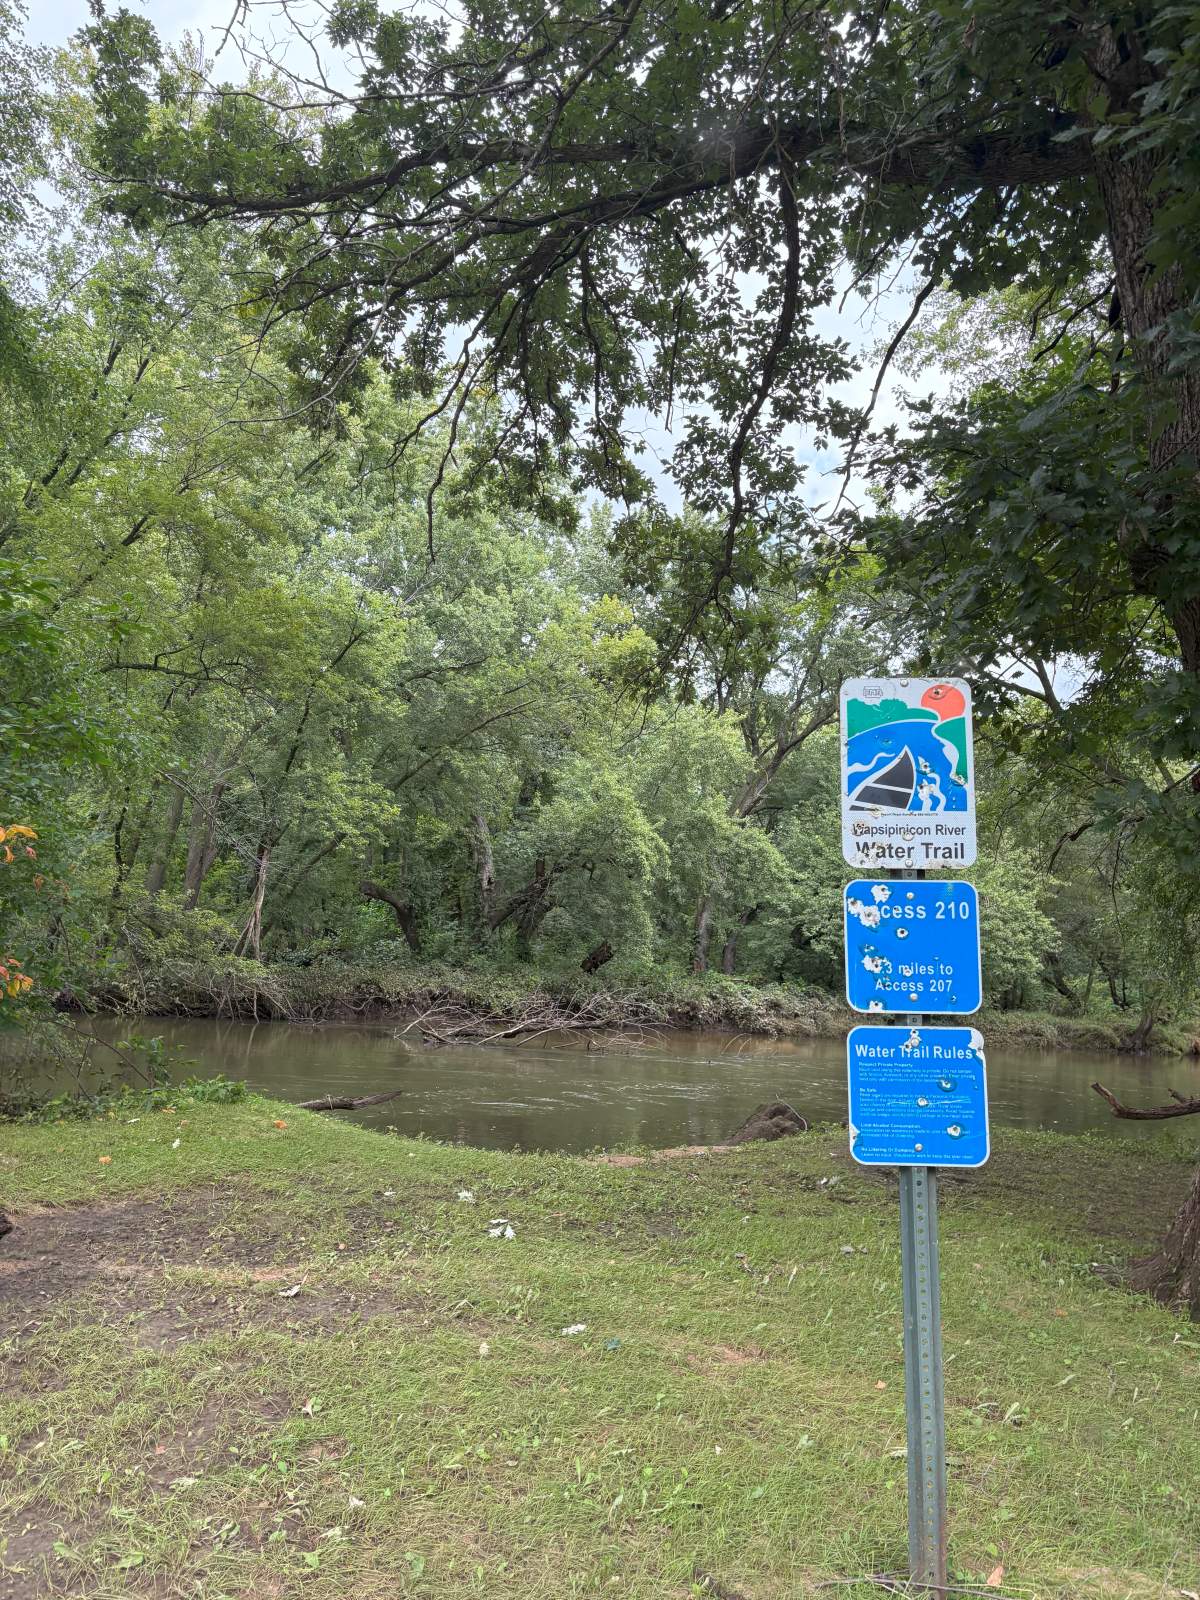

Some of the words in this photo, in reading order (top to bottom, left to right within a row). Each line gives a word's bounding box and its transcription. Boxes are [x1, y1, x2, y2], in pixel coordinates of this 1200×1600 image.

[935, 824, 966, 836] River
[856, 842, 915, 858] Water
[921, 843, 965, 859] Trail
[935, 901, 970, 919] 210
[898, 962, 935, 975] miles
[940, 963, 953, 975] to
[875, 979, 924, 991] Access
[929, 980, 953, 992] 207
[855, 1044, 896, 1058] Water
[899, 1045, 929, 1059] Trail
[933, 1046, 973, 1060] Rules
